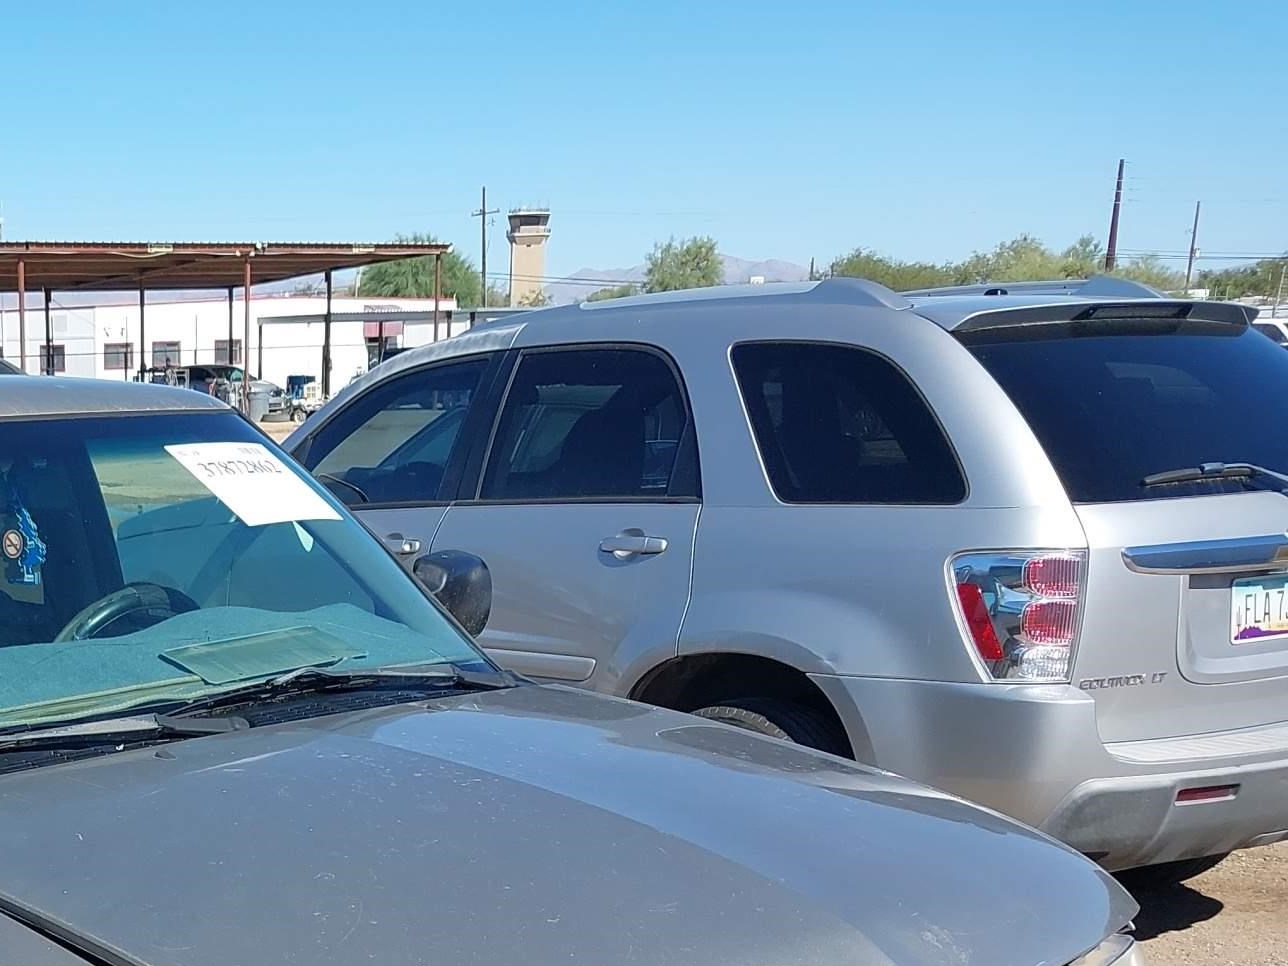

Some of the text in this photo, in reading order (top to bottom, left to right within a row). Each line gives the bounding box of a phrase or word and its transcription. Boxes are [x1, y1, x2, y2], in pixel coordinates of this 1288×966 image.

[197, 459, 282, 477] 37872862
[1245, 590, 1288, 625] FLA 7
[1152, 672, 1168, 684] LT
